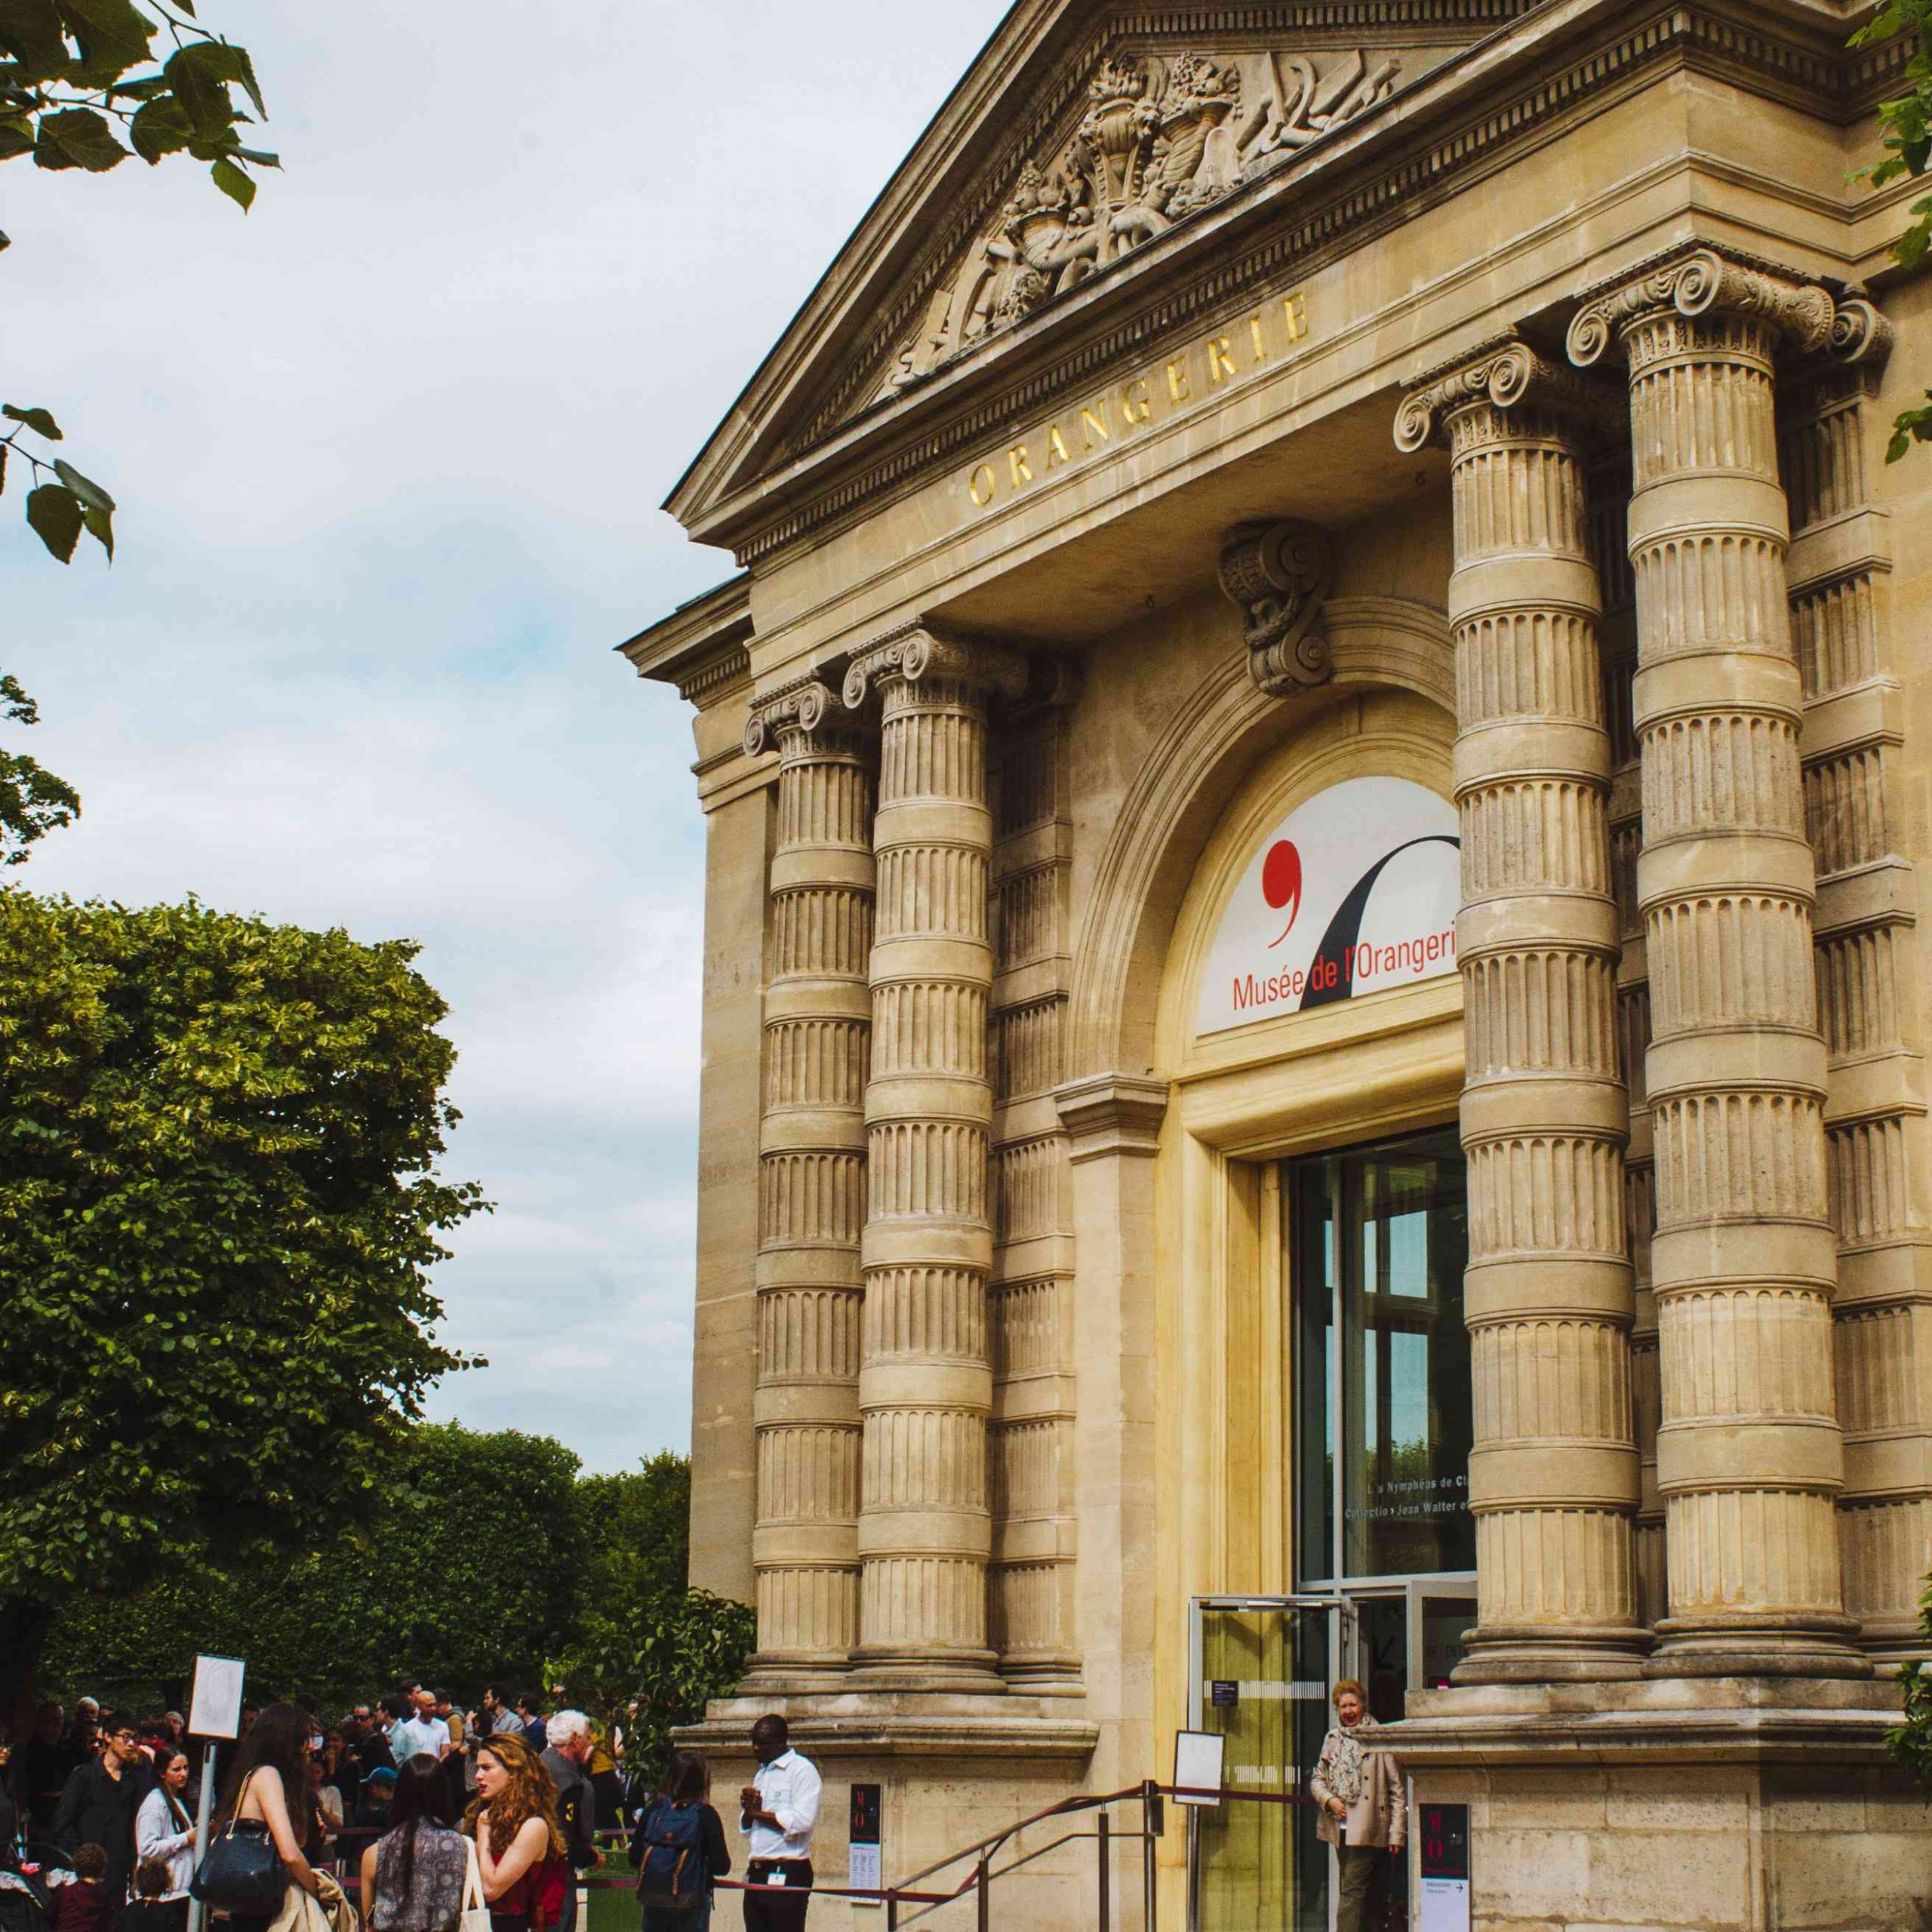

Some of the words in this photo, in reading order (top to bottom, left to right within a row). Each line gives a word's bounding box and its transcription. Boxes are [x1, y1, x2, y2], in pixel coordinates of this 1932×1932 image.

[968, 292, 1309, 507] ORANGERIE
[1232, 964, 1304, 1011] Musée
[1311, 955, 1338, 992] de
[1344, 920, 1457, 983] l'Orangeri
[1367, 1482, 1384, 1494] Ls
[1440, 1476, 1452, 1487] de
[1456, 1475, 1469, 1487] Cl
[1397, 1504, 1420, 1516] Jean
[1423, 1500, 1457, 1513] Walter
[1460, 1501, 1469, 1510] e
